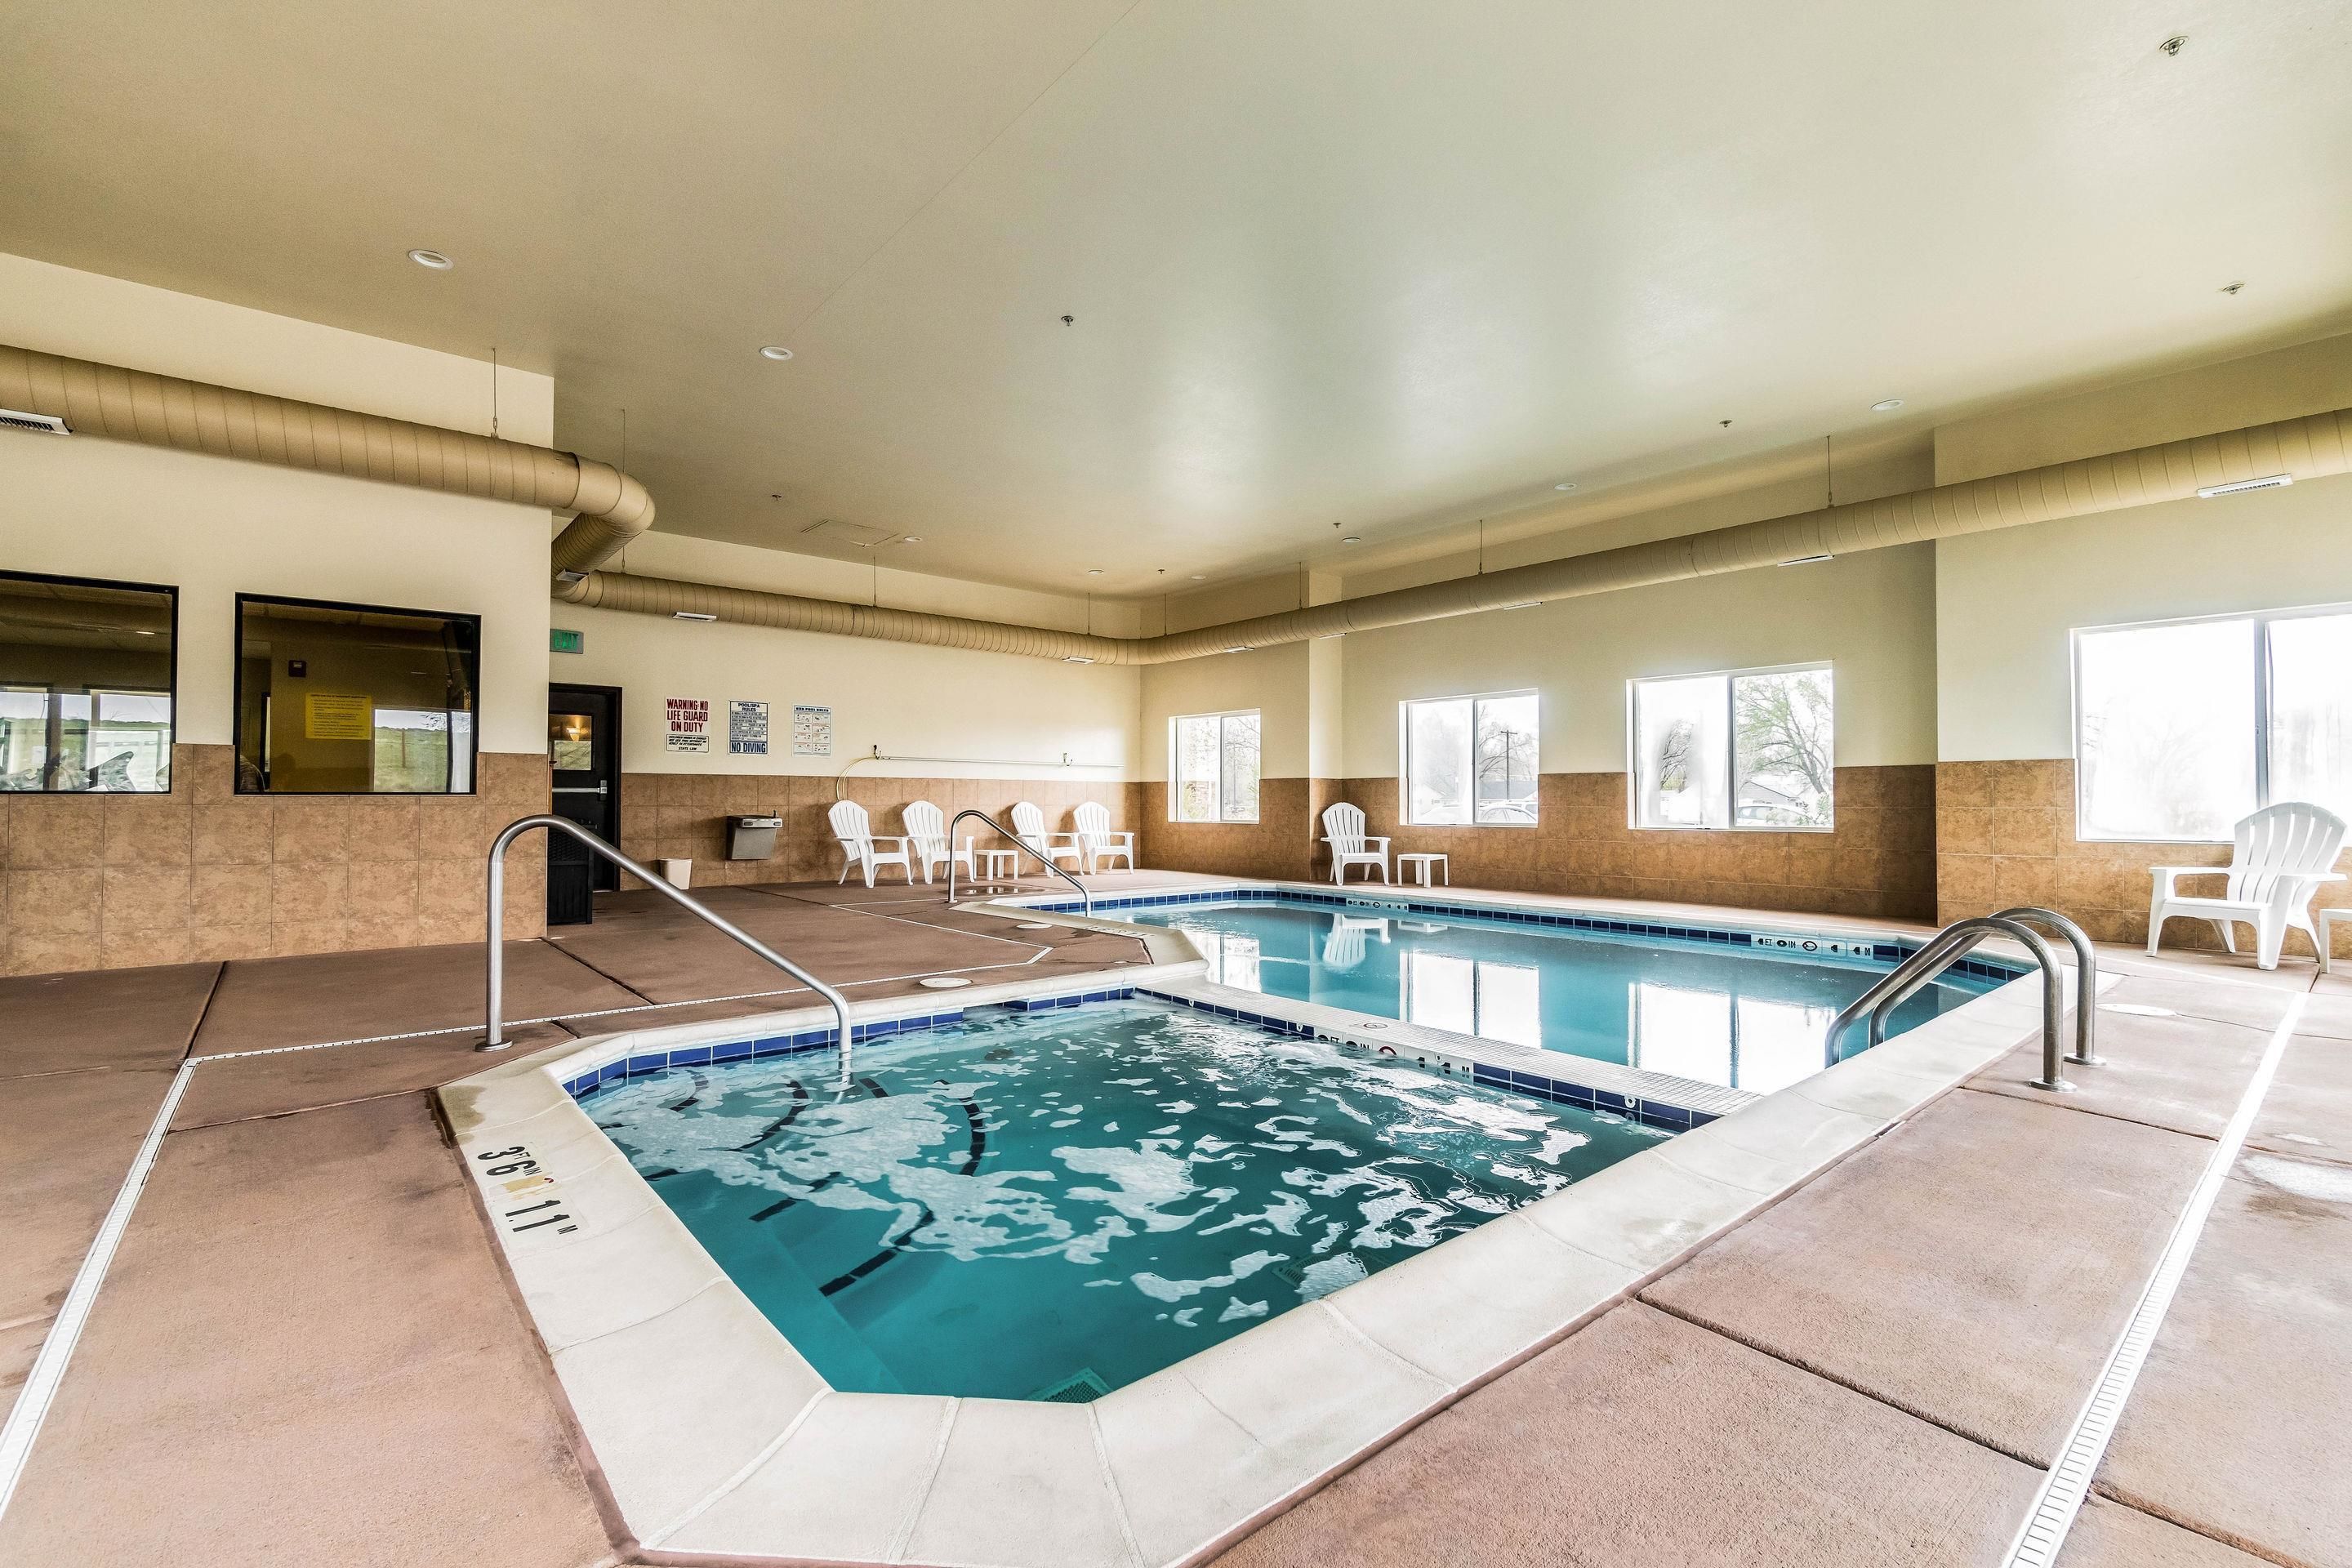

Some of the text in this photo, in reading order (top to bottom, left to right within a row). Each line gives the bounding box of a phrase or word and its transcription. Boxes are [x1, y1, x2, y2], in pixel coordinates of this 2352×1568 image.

[554, 631, 578, 649] EXIT
[700, 701, 708, 710] NO
[667, 710, 708, 721] LIFE GUARD
[671, 721, 703, 733] ON DUTY
[732, 742, 766, 753] NO DIVING
